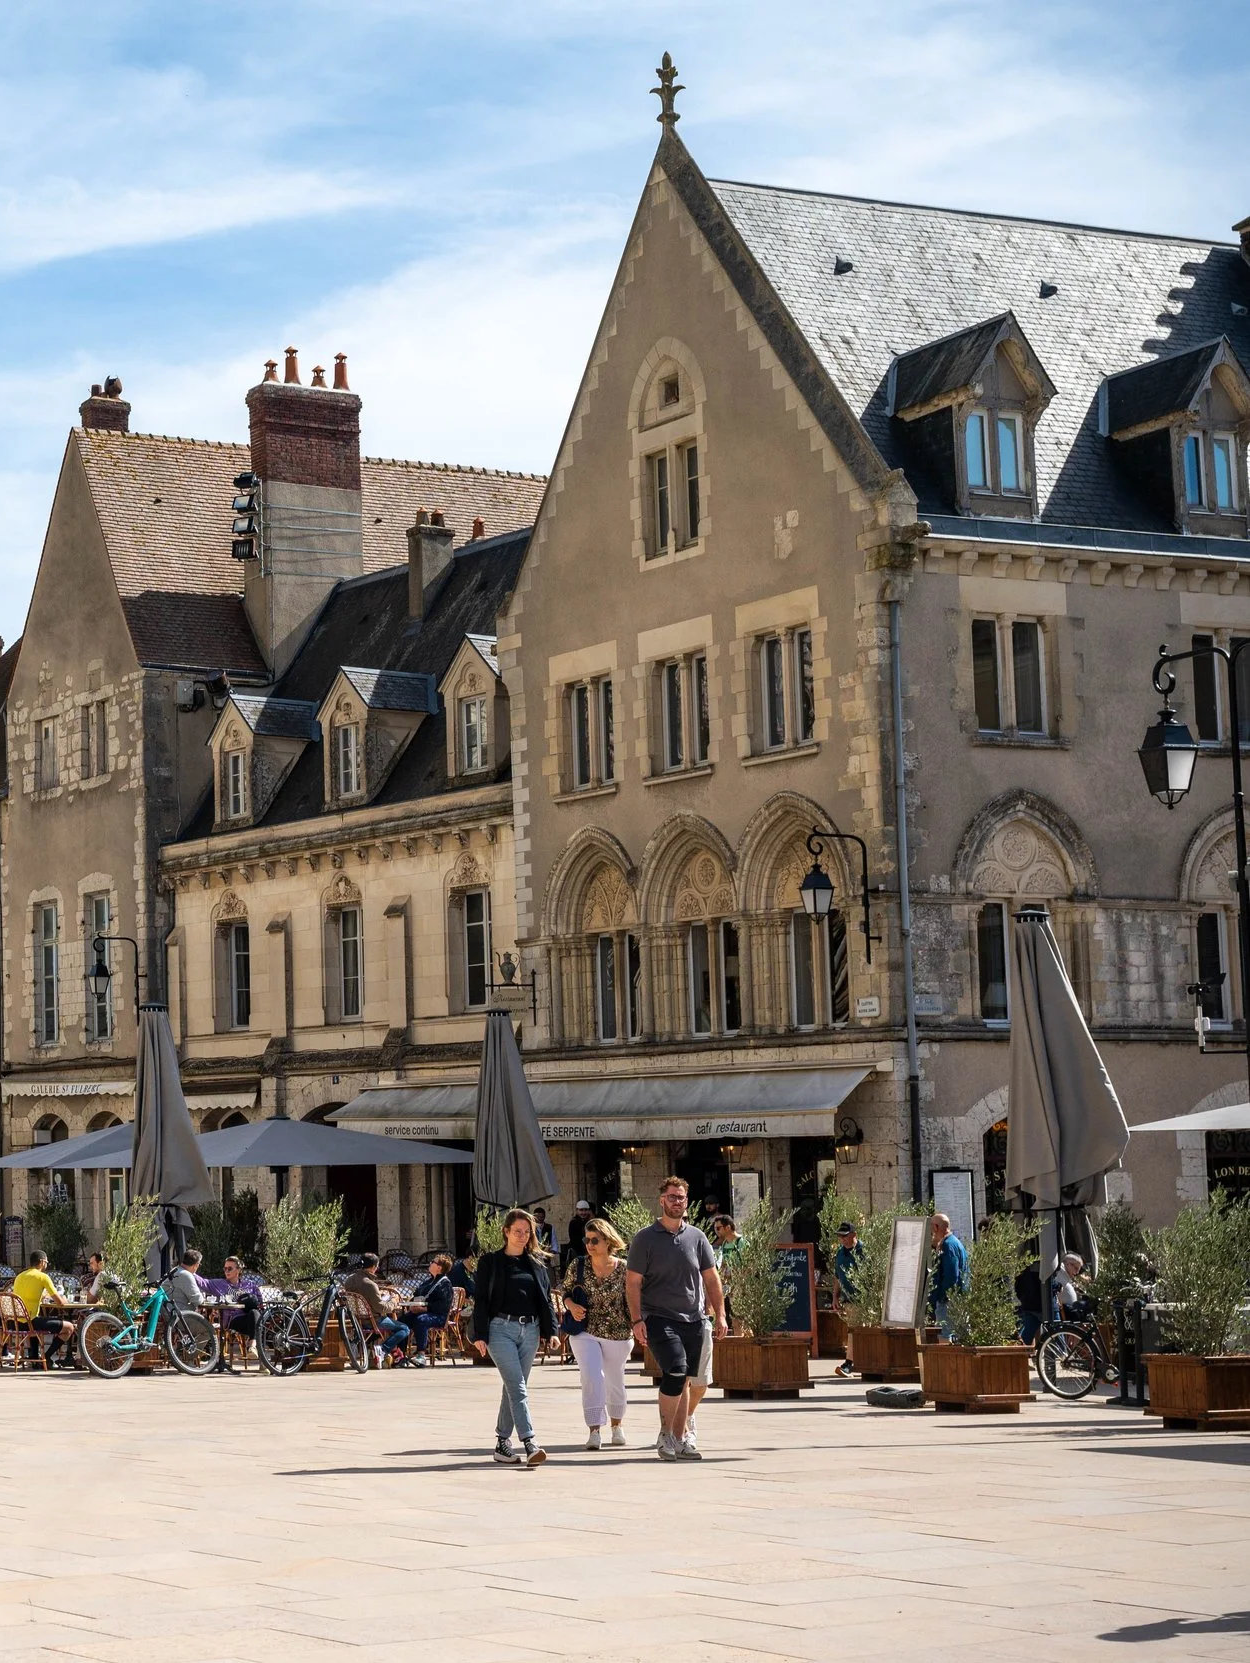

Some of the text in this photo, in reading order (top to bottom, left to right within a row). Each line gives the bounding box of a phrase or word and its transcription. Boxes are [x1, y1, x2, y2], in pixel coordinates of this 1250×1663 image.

[31, 1085, 60, 1094] GALERIE
[70, 1083, 102, 1094] FULBERT
[384, 1125, 439, 1136] service continu
[541, 1123, 595, 1137] FÉ SERPENTE
[716, 1120, 768, 1134] restaurant
